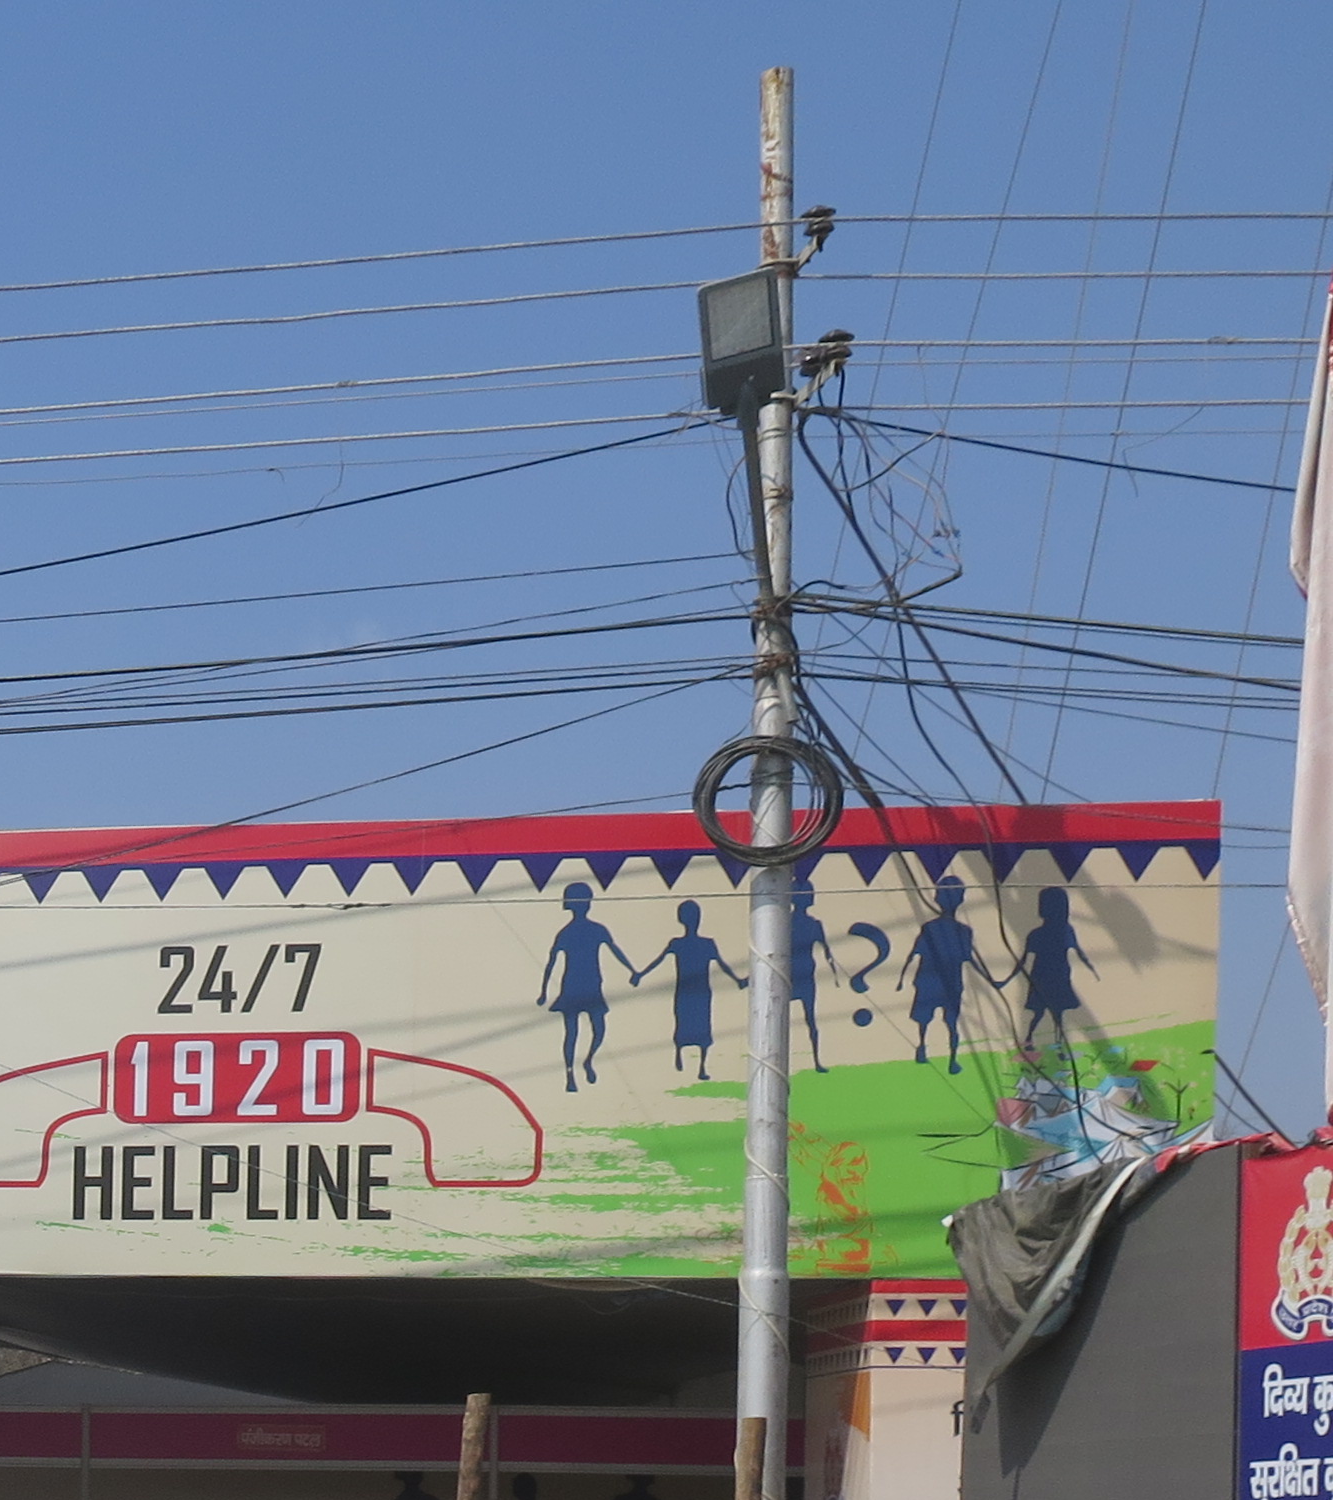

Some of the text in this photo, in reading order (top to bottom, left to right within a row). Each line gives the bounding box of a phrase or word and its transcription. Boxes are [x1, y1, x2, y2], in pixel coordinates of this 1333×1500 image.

[157, 943, 321, 1014] 24/7
[131, 1037, 346, 1117] 1920
[72, 1144, 392, 1221] HELPLINE
[1263, 1363, 1310, 1418] दिव्य
